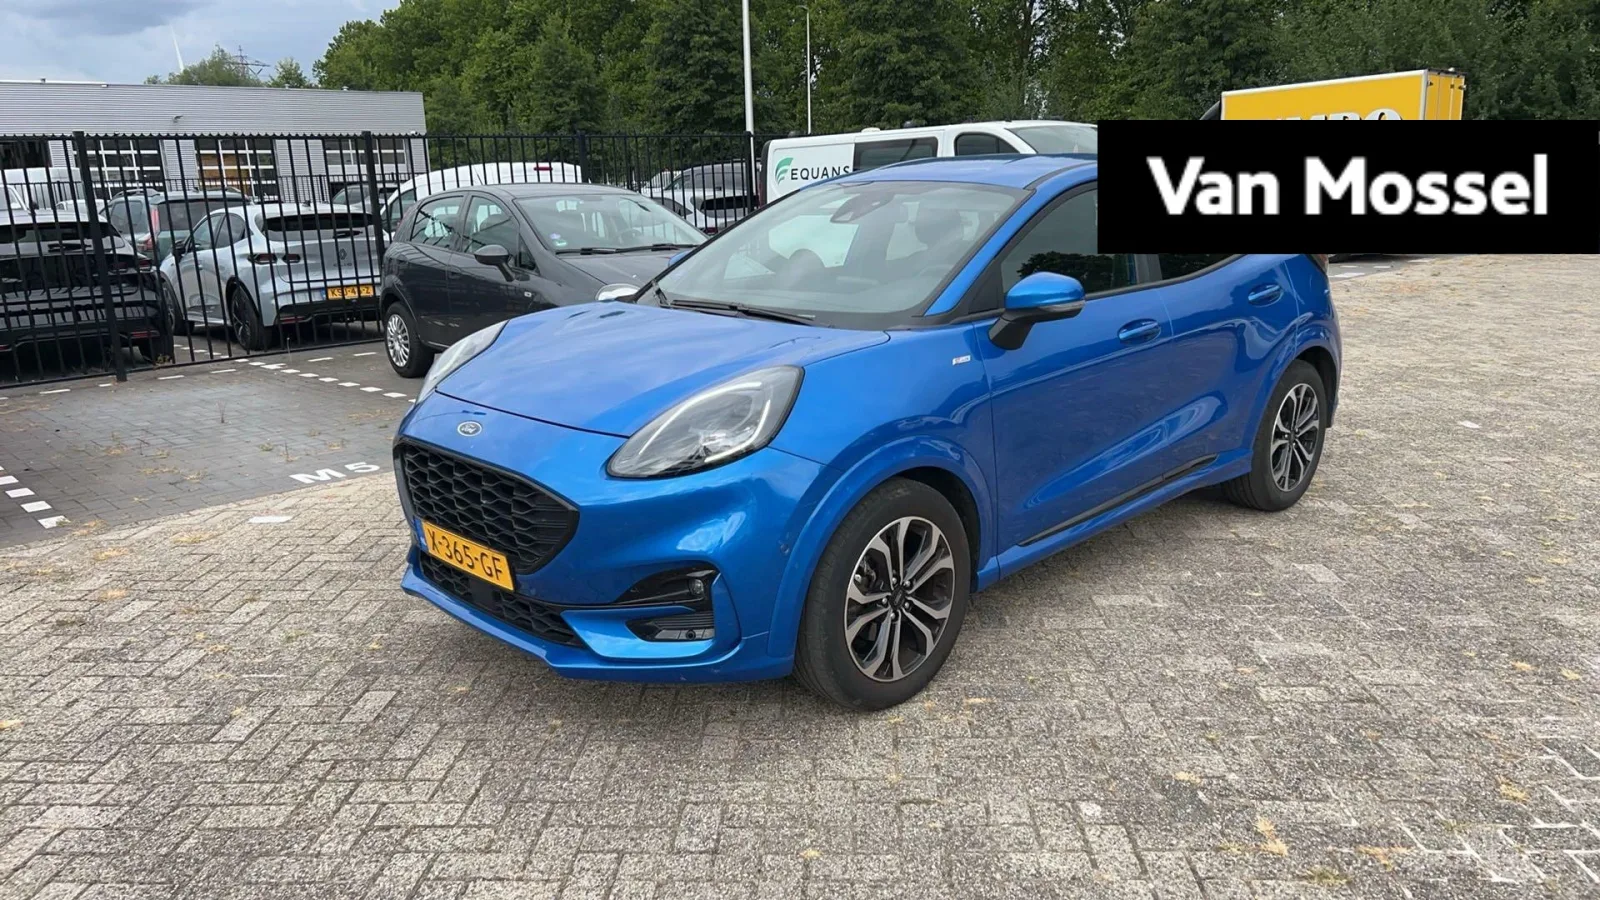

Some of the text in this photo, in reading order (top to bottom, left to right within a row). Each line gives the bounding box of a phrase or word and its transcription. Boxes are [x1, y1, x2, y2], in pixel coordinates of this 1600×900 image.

[790, 166, 850, 180] EQUANS
[330, 286, 371, 297] KSJ-4-Z
[427, 528, 503, 581] X-365-GF
